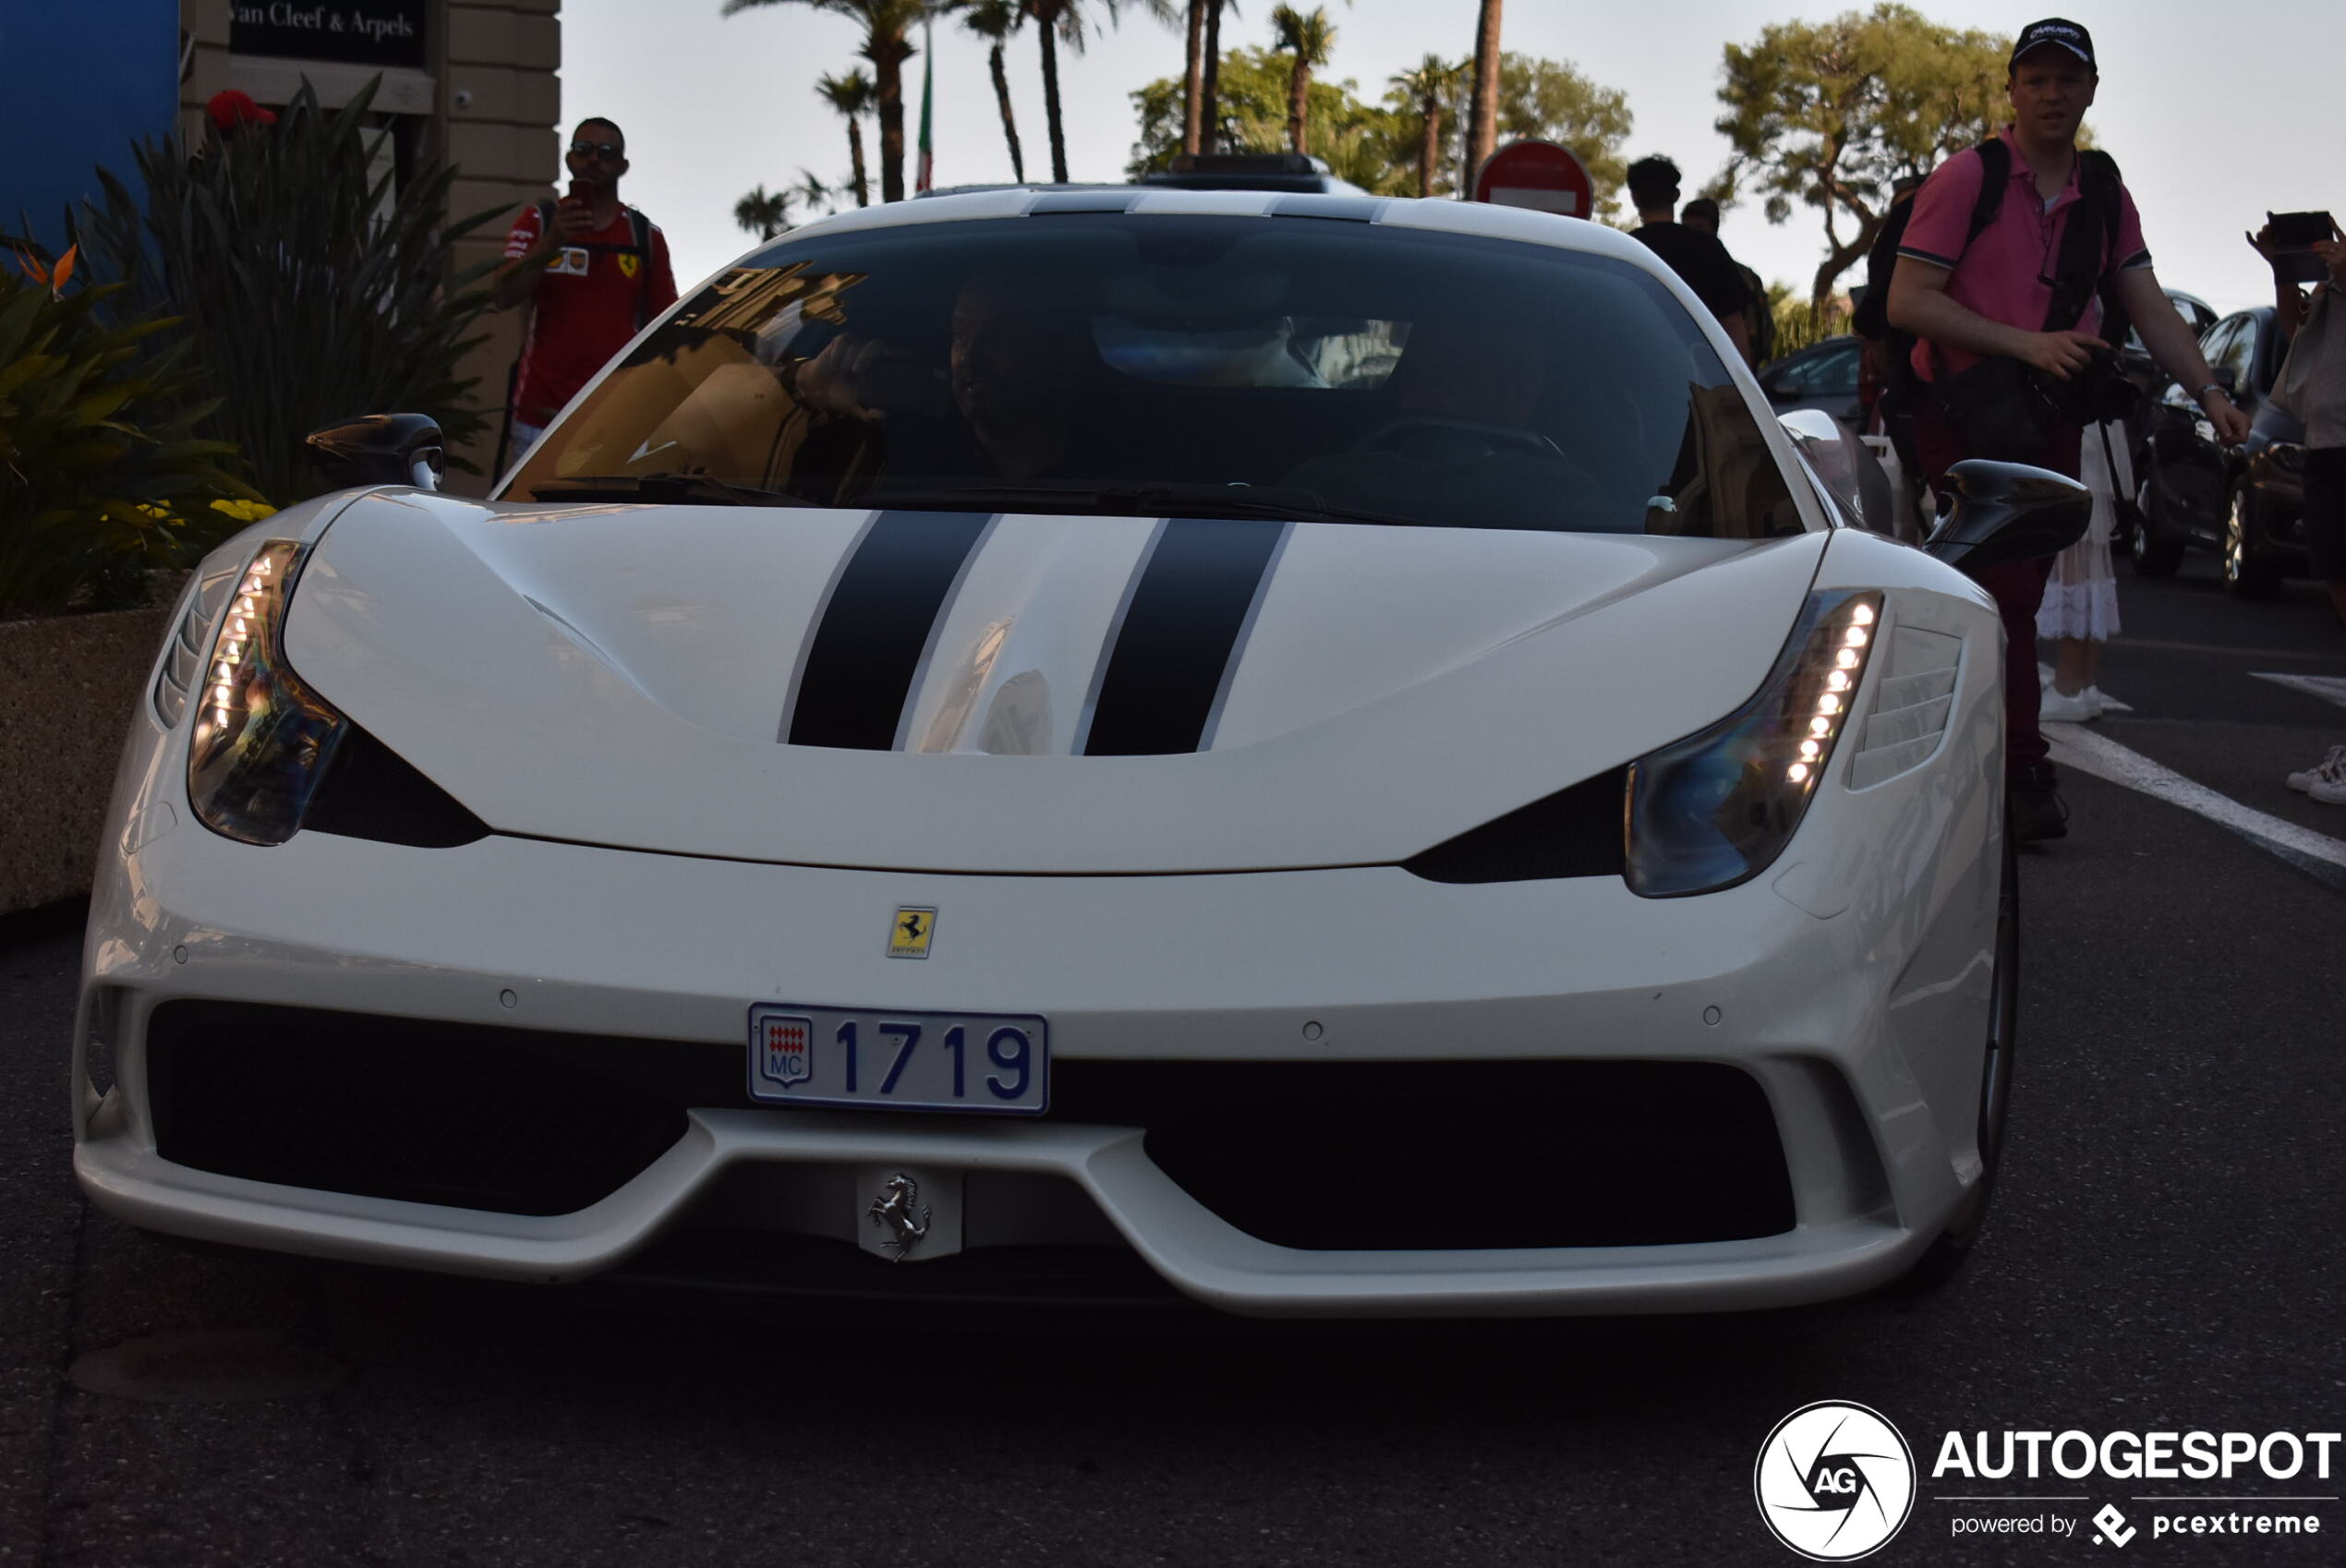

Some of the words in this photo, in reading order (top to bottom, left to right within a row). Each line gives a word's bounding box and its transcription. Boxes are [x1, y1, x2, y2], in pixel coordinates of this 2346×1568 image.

[269, 1, 325, 30] Cleef
[329, 12, 344, 33] &
[350, 9, 414, 42] Arpels
[770, 1055, 803, 1076] MC
[837, 1019, 1030, 1100] 1719
